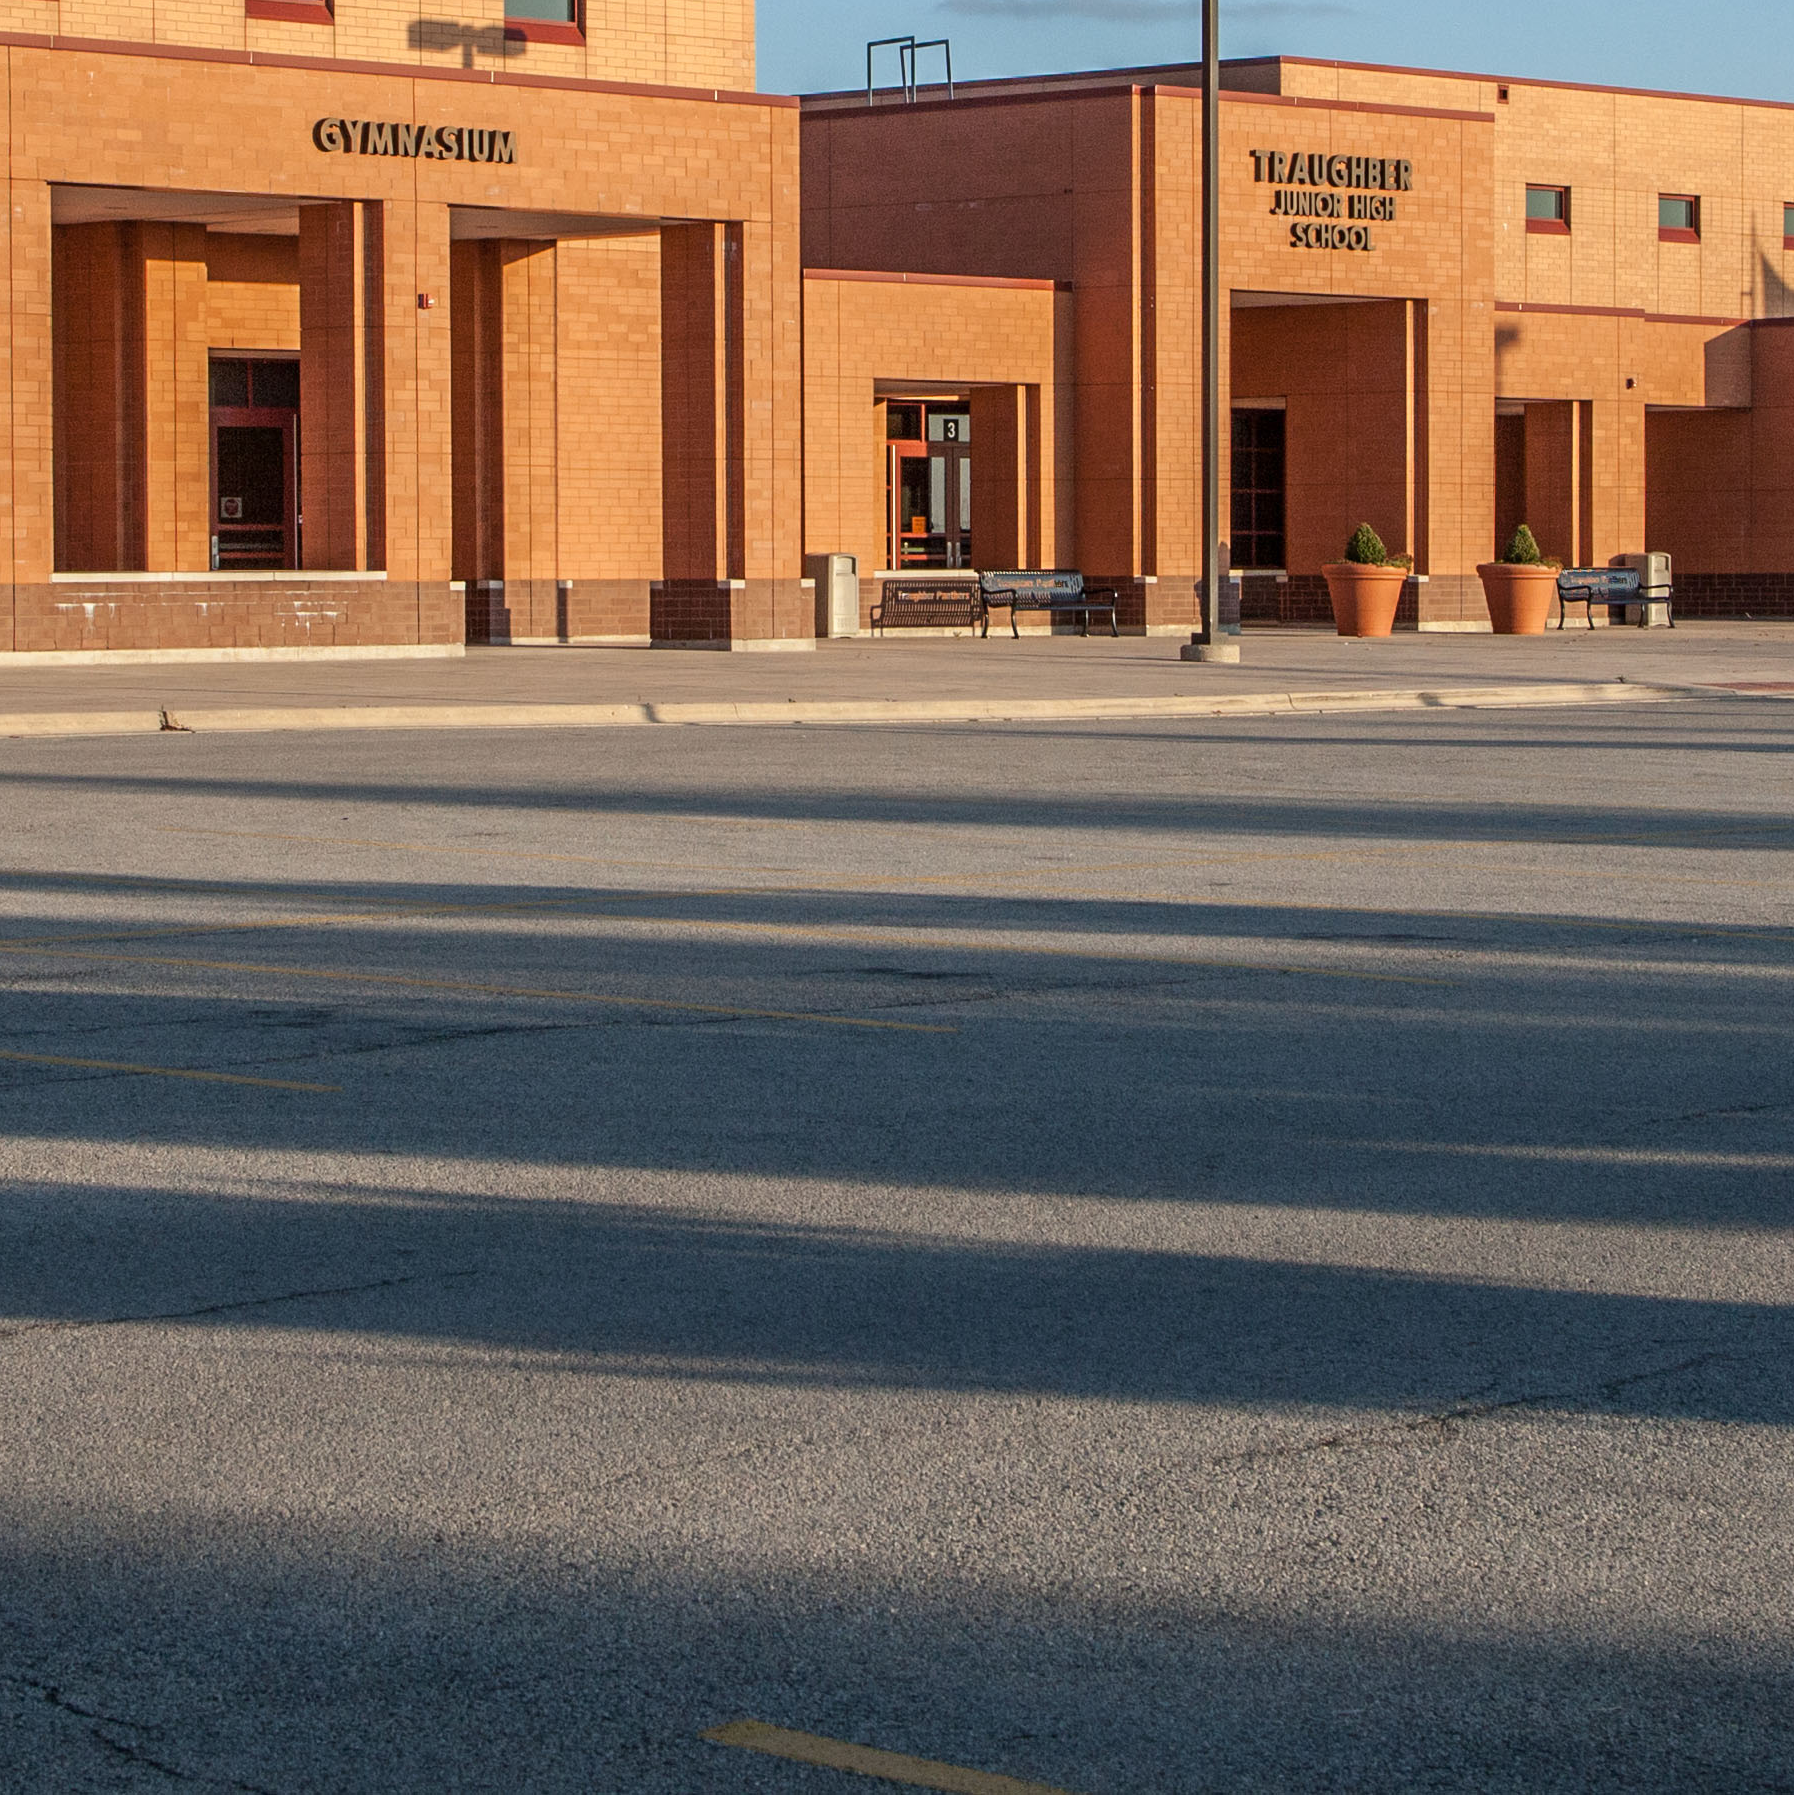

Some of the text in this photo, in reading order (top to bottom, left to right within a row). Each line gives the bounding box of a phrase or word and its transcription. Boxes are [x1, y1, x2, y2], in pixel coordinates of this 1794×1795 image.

[312, 117, 517, 164] GYMNASIUM
[1249, 149, 1413, 191] TRAUGHBER
[1269, 189, 1396, 221] JUNIOR HIGH
[1290, 222, 1376, 251] SCHOOL
[947, 422, 956, 438] 3
